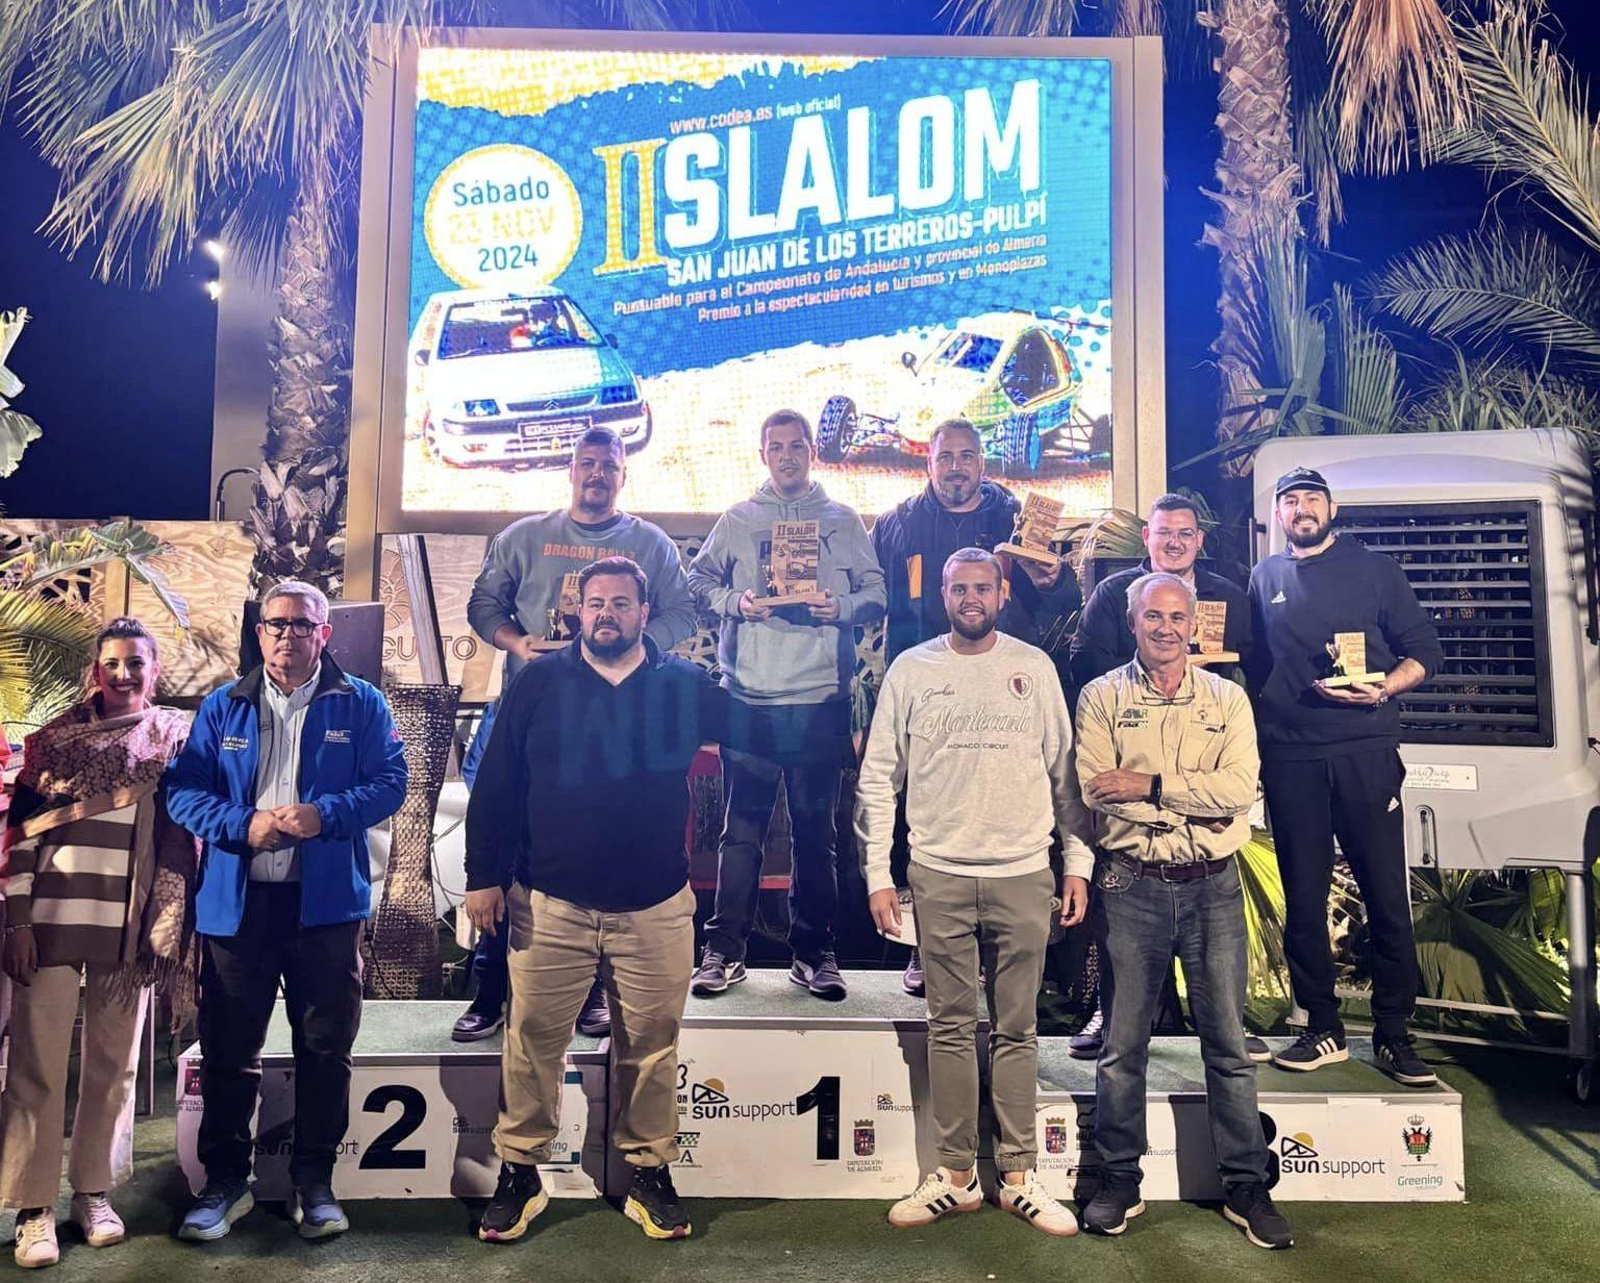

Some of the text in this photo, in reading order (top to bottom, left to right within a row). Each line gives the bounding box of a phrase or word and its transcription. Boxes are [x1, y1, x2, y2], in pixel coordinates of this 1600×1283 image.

[670, 93, 841, 134] www.codea.es (web oficial)
[453, 176, 550, 207] Sábado
[593, 78, 1040, 276] II SLALOM
[493, 205, 555, 240] NOV
[478, 243, 538, 272] 2024
[667, 253, 711, 286] SAN
[717, 242, 776, 279] JUAN
[782, 237, 810, 268] DE
[816, 230, 856, 262] LOS
[613, 293, 682, 316] Puntuable
[686, 289, 716, 307] para
[720, 284, 733, 299] el
[737, 271, 821, 297] Campeonato
[824, 266, 841, 282] de
[913, 254, 922, 269] y
[926, 240, 982, 268] provincial
[698, 301, 741, 323] Premio
[744, 303, 752, 316] a
[754, 299, 766, 314] la
[768, 280, 872, 312] espectacularidad
[875, 281, 889, 295] en
[892, 270, 944, 291] turismos
[948, 270, 956, 285] y
[543, 543, 596, 560] DRAGON
[359, 1084, 427, 1170] 2
[692, 1099, 796, 1121] sun support
[796, 1076, 841, 1160] 1
[1281, 1158, 1386, 1178] sun support
[1397, 1174, 1443, 1187] Greening
